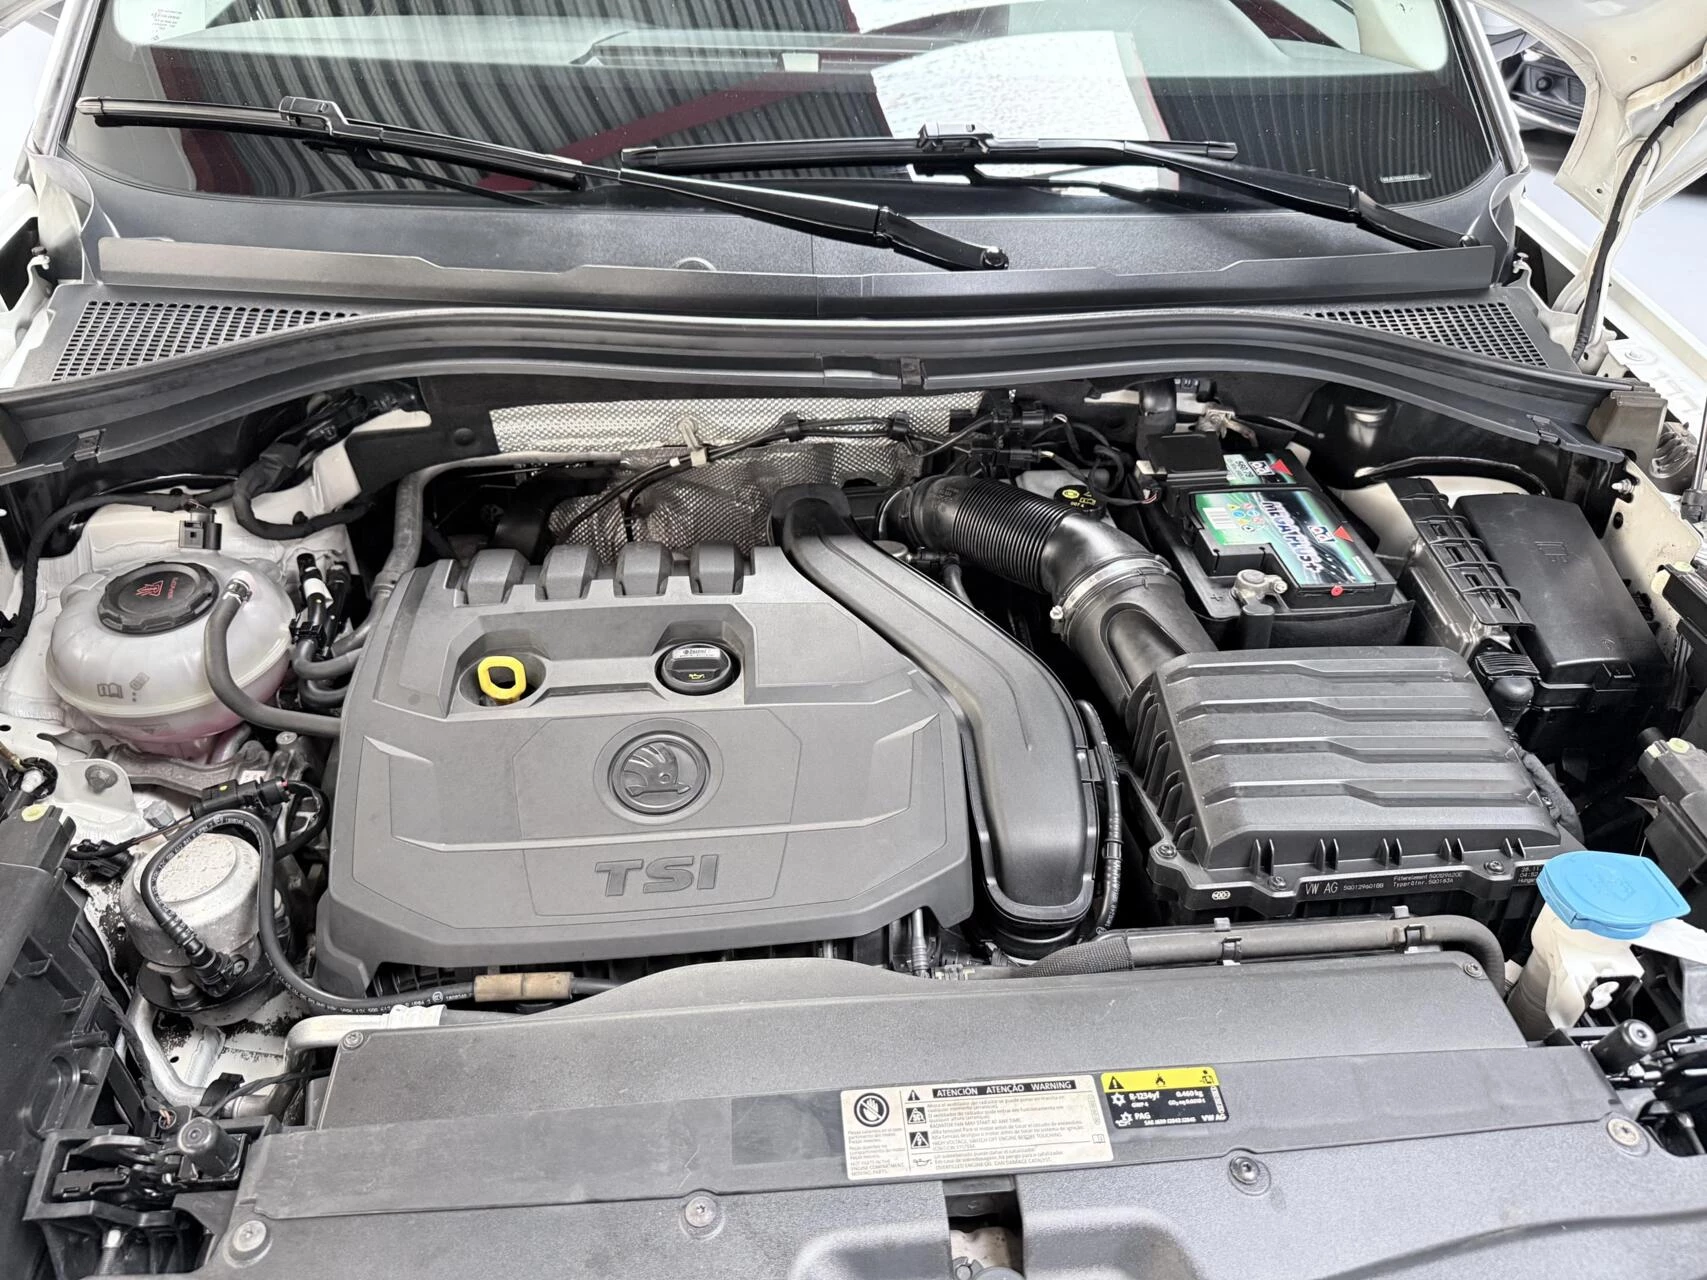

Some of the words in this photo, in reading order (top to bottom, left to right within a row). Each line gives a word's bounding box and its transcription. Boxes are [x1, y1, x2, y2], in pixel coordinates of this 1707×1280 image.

[594, 854, 720, 897] TSI
[1305, 883, 1320, 895] VW
[1323, 882, 1339, 894] AG
[1031, 1081, 1072, 1091] WARNING
[1134, 1112, 1151, 1120] PAG
